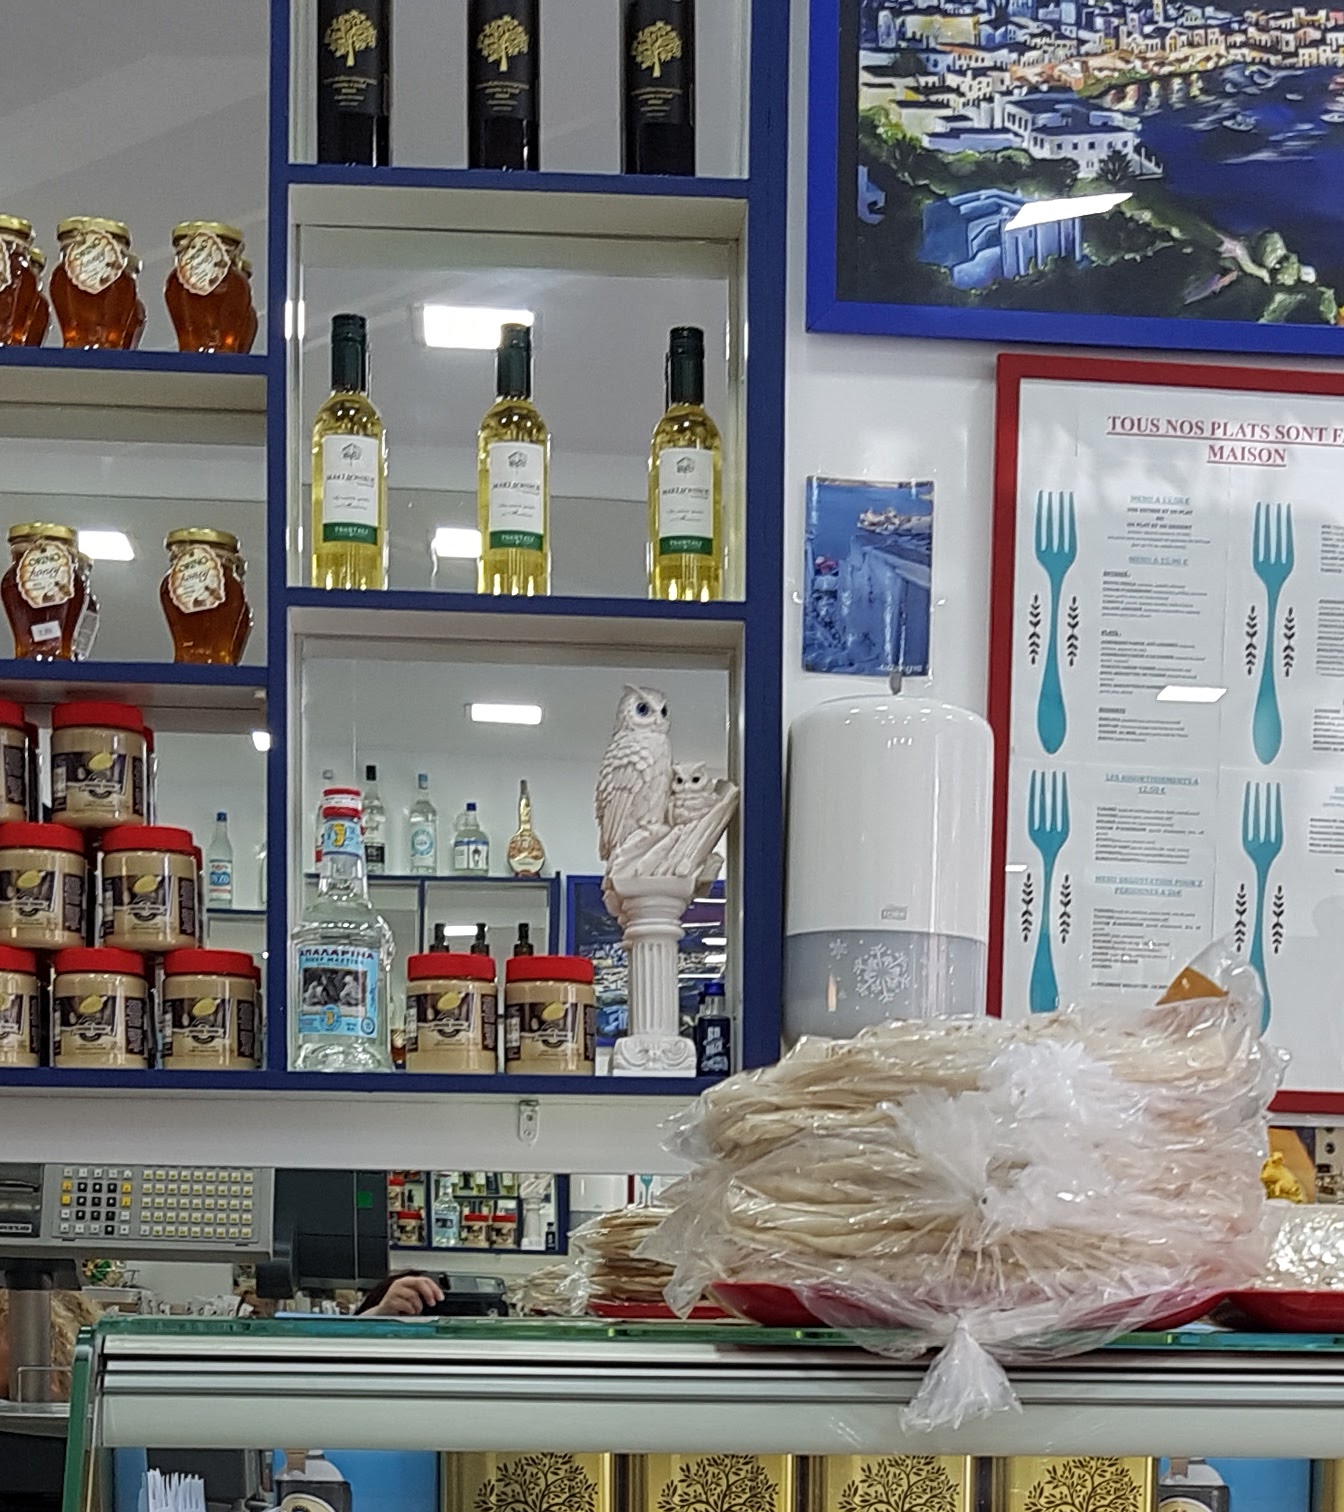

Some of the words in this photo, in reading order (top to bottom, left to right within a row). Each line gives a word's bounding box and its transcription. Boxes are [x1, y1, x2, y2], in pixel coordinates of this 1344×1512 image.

[1107, 416, 1160, 433] TOUS
[1166, 419, 1204, 436] NOS
[1210, 421, 1270, 439] PLATS
[1275, 425, 1328, 442] SONT
[1208, 445, 1286, 463] MAISON
